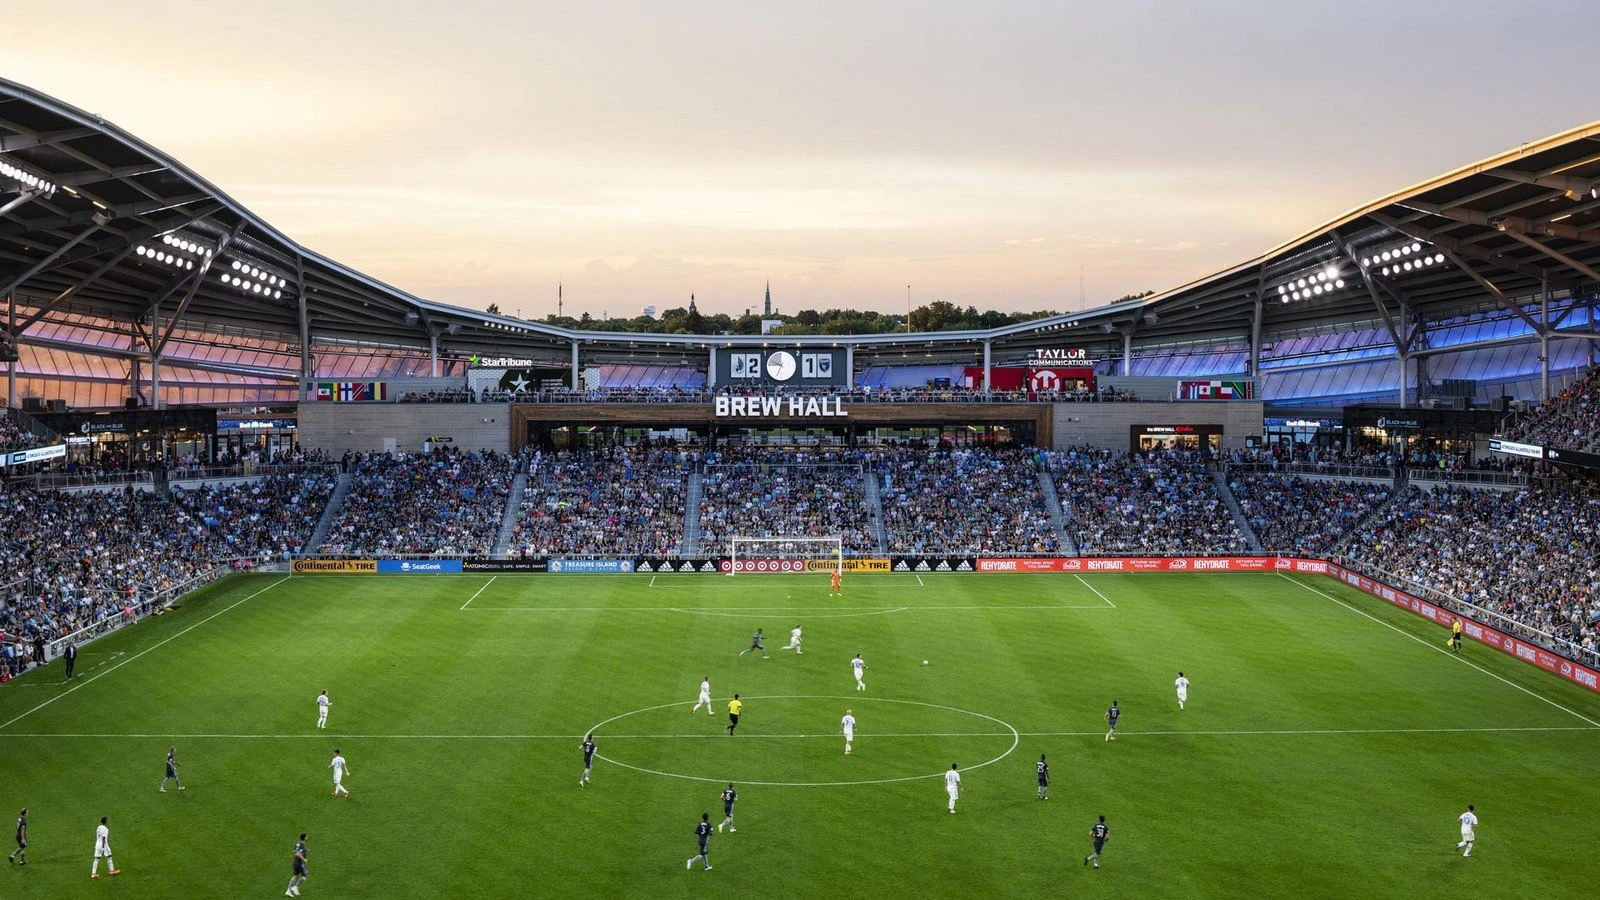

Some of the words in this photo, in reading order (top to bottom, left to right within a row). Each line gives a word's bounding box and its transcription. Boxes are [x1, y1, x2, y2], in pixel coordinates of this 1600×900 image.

[1036, 348, 1086, 358] TAYLOR
[481, 358, 532, 366] StarTribune
[749, 358, 758, 374] 2
[806, 358, 813, 374] 1
[715, 396, 782, 416] BREW
[789, 396, 848, 416] HALL
[294, 561, 344, 572] Continental
[981, 562, 1017, 570] REHYDRATE
[1088, 561, 1124, 569] REHYDRATE
[1194, 560, 1230, 569] REHYDRATE
[726, 792, 730, 800] 6
